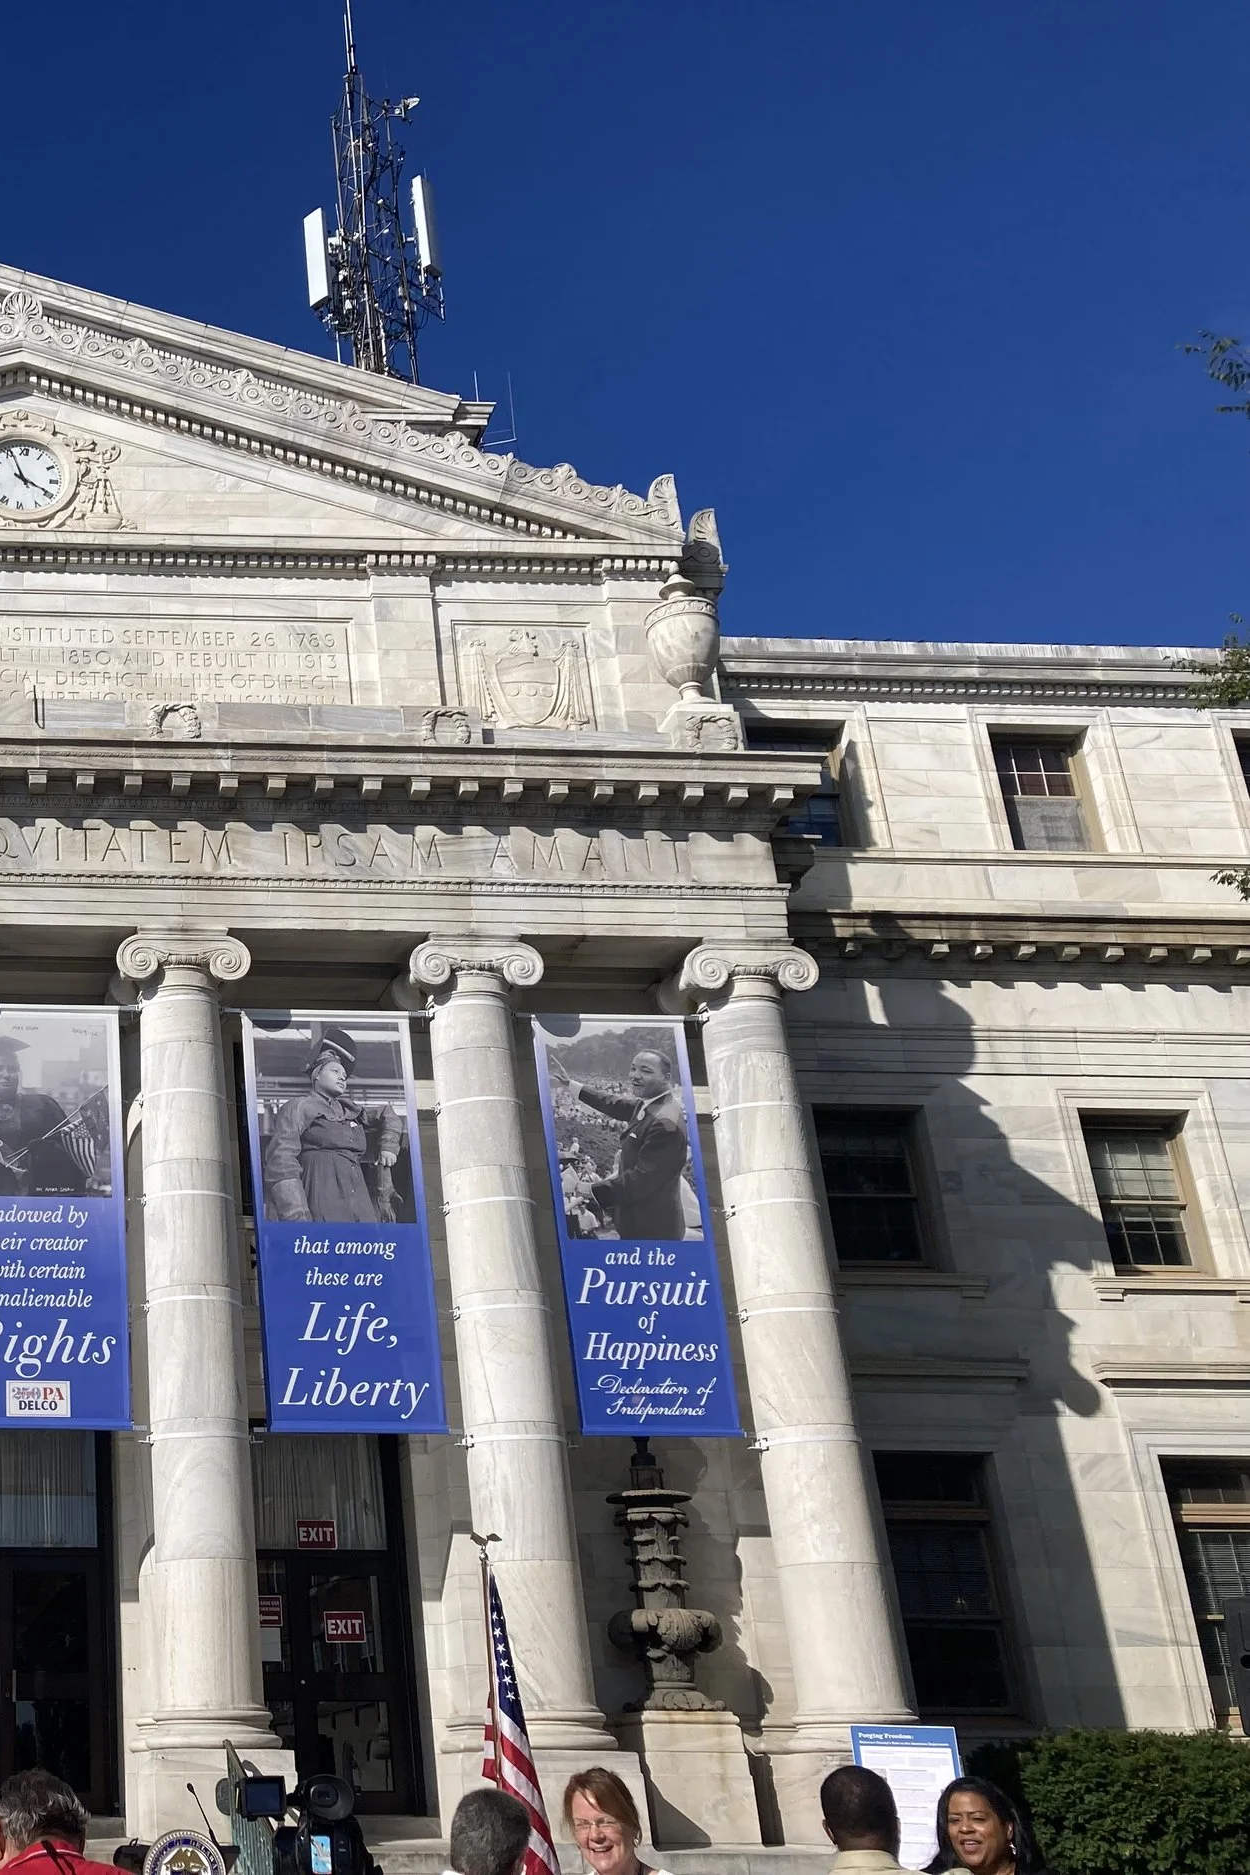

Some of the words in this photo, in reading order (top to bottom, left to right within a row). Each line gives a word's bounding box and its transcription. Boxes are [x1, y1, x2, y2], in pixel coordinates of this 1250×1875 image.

[122, 630, 235, 647] SEPTEMBER
[250, 632, 276, 647] 26
[288, 632, 336, 648] 1789
[30, 649, 52, 664] IN
[62, 650, 112, 665] 1850
[123, 652, 165, 667] AND
[176, 653, 257, 669] REBUILT
[267, 654, 288, 669] IN
[297, 655, 338, 670] 1913
[56, 671, 148, 687] DISTRICT
[180, 674, 225, 689] LINE
[230, 674, 257, 689] OF
[263, 675, 338, 690] DIRECT
[283, 831, 443, 868] IPSAM
[490, 835, 688, 873] AMANT
[68, 1205, 88, 1228] by
[30, 1236, 88, 1252] creator
[294, 1235, 330, 1254] that
[335, 1241, 396, 1260] among
[605, 1247, 641, 1266] and
[648, 1247, 676, 1266] the
[29, 1261, 86, 1280] certain
[305, 1267, 350, 1286] these
[354, 1272, 384, 1287] are
[575, 1267, 710, 1306] Pursuit
[298, 1301, 398, 1356] Life,
[638, 1310, 659, 1334] of
[583, 1332, 719, 1370] Happiness
[43, 1387, 65, 1401] PA
[278, 1367, 430, 1420] Liberty
[696, 1377, 717, 1406] of
[19, 1400, 58, 1411] DELCO
[606, 1395, 707, 1423] Independence
[299, 1527, 333, 1542] EXIT
[327, 1619, 362, 1635] EXIT
